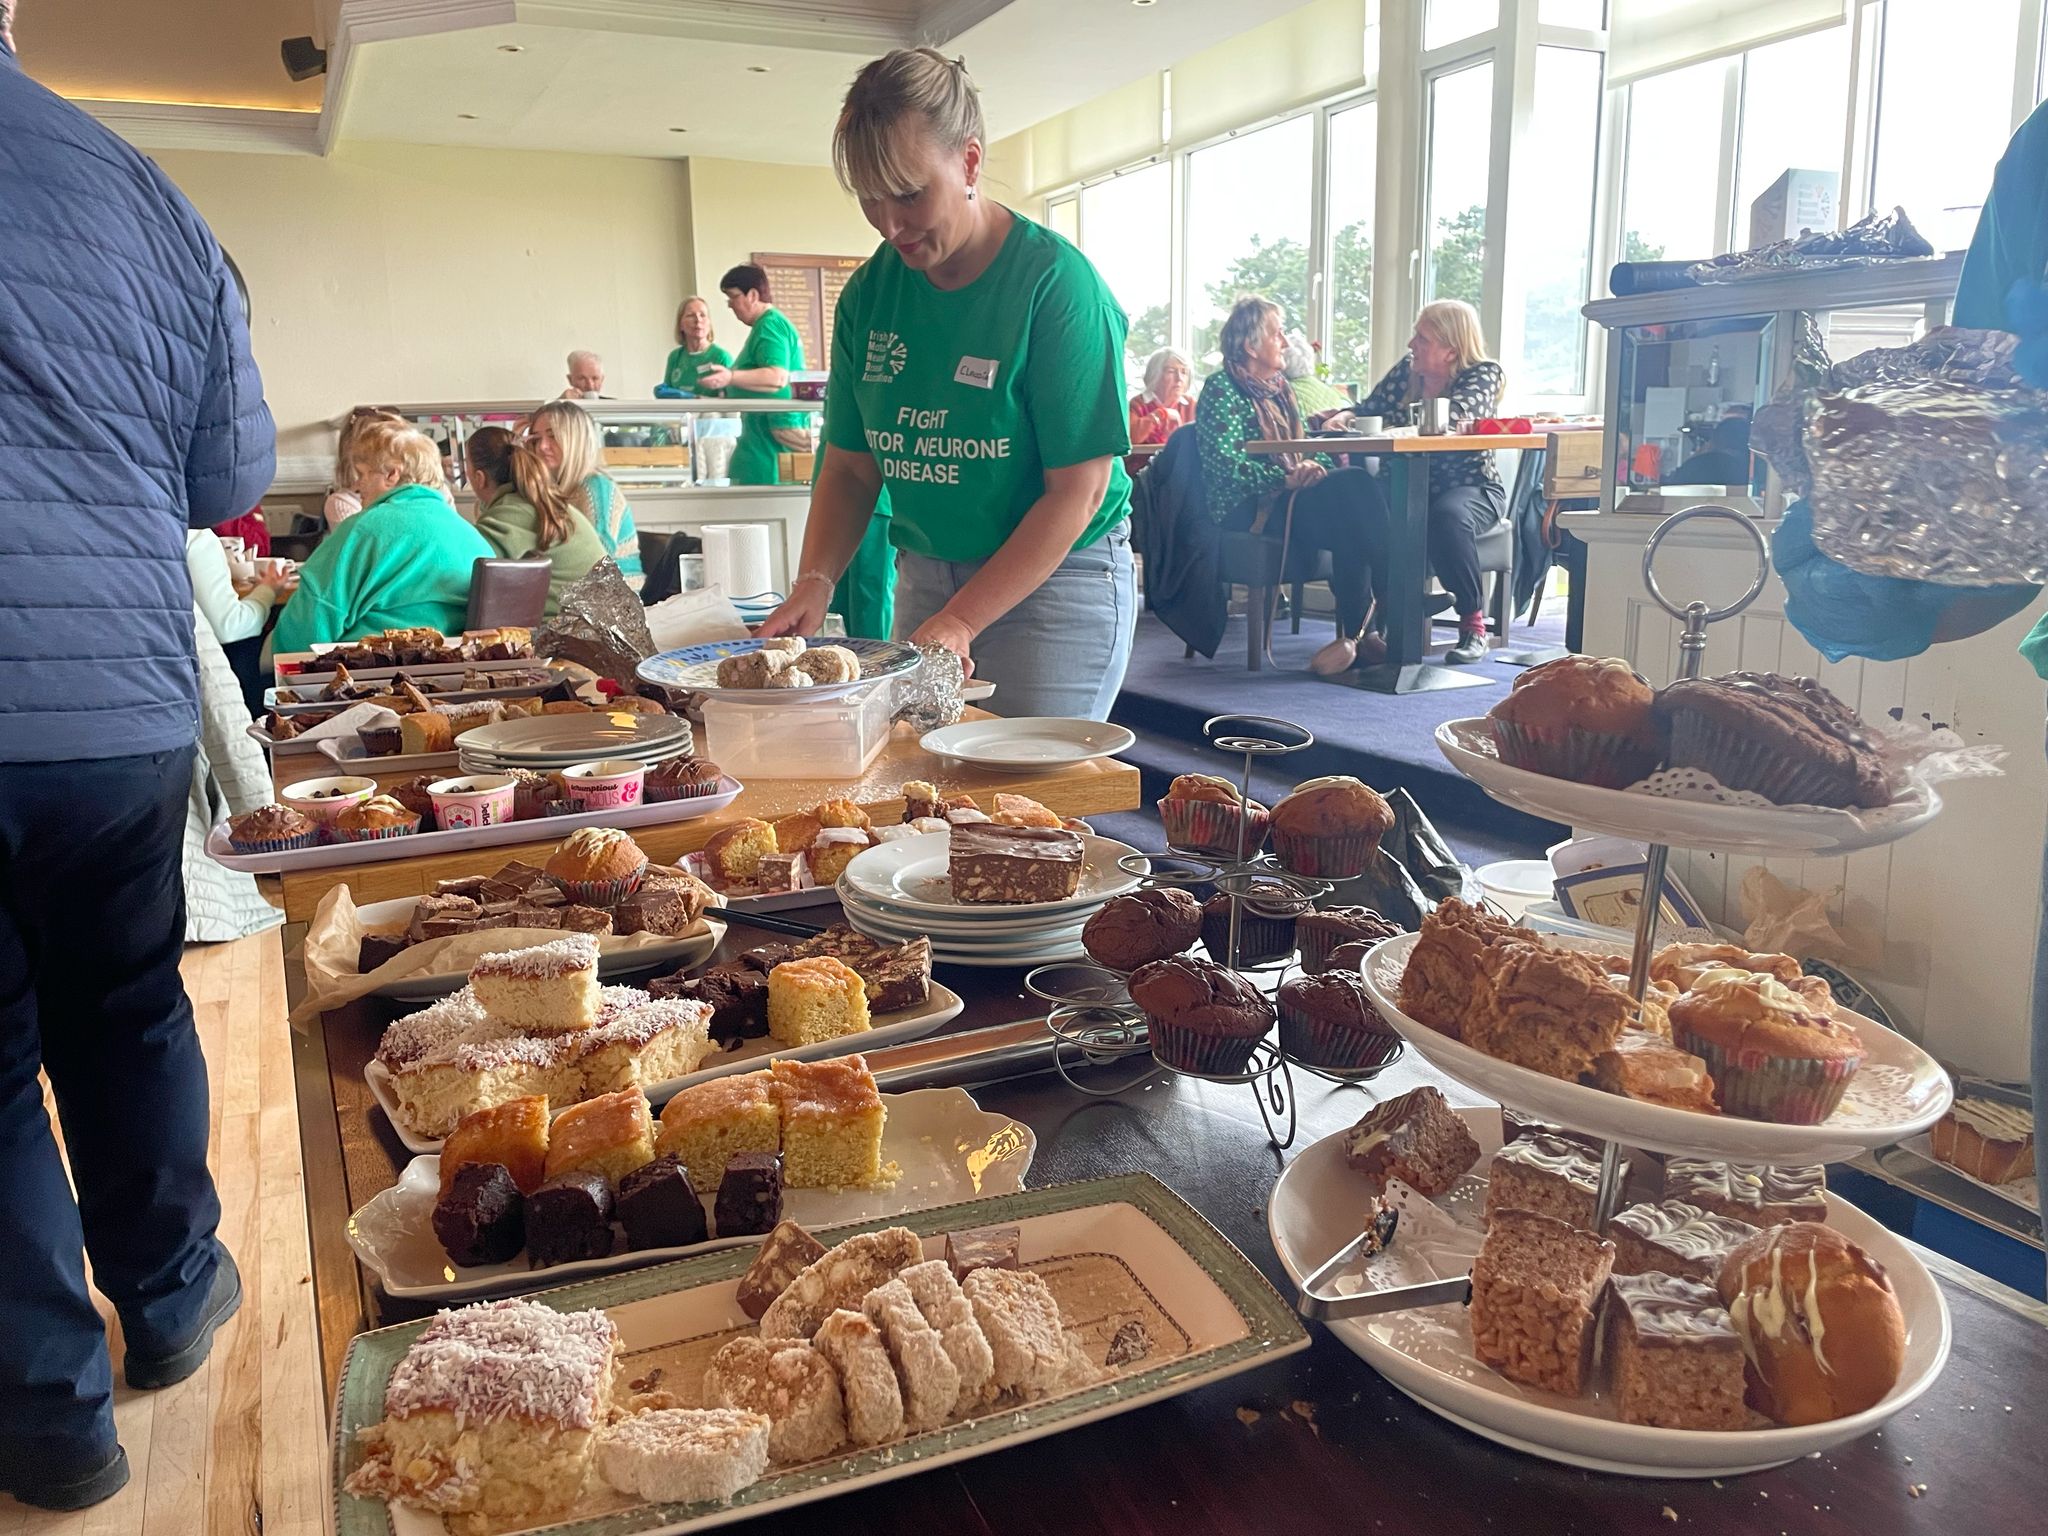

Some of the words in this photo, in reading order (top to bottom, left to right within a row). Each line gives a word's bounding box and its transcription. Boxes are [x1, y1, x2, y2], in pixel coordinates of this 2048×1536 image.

[869, 329, 889, 342] Irish
[896, 406, 949, 429] FIGHT
[864, 427, 904, 453] OTOR
[913, 437, 1011, 460] NEURONE
[883, 458, 960, 485] DISEASE
